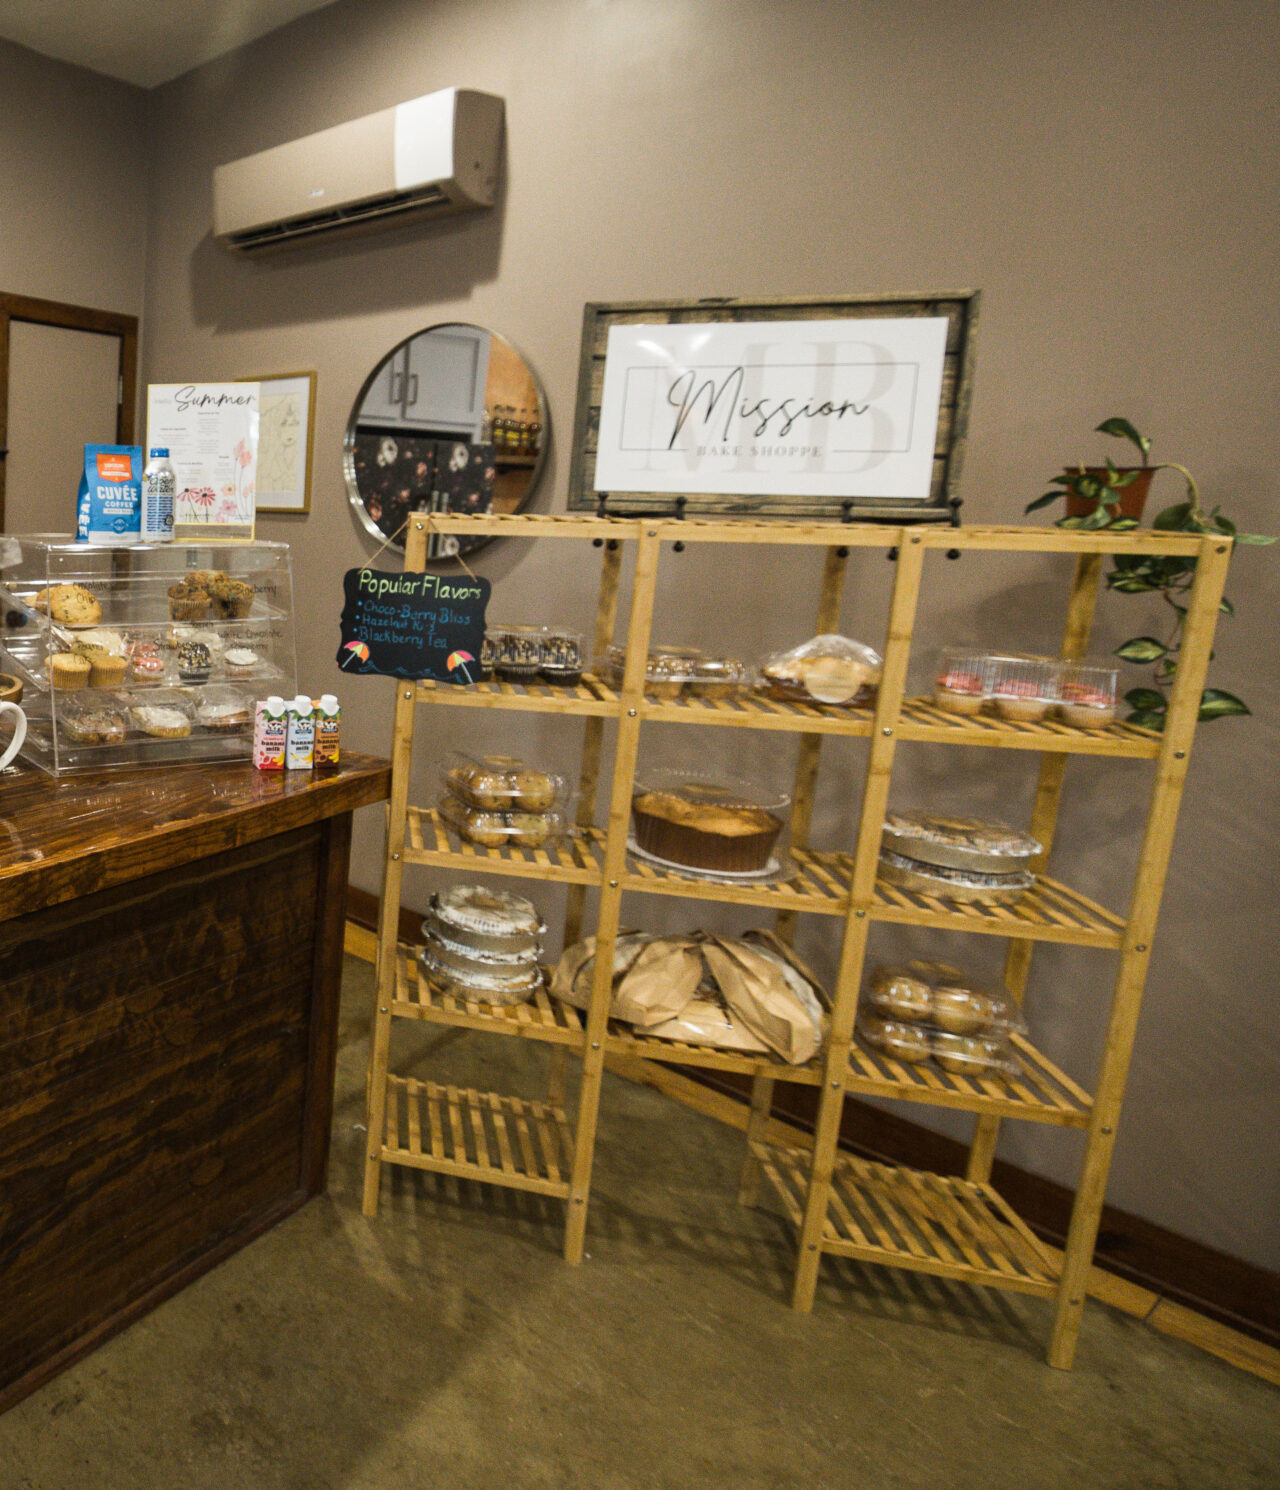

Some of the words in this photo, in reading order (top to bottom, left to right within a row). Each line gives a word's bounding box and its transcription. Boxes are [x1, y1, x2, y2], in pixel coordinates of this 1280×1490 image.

[175, 385, 255, 412] Summer
[668, 366, 869, 451] Mission
[696, 444, 742, 458] BAKE
[750, 444, 824, 459] SHOPPE
[97, 485, 138, 502] CUVÉE
[359, 570, 420, 599] Popular
[422, 576, 482, 600] Flavors
[439, 607, 472, 625] Bliss
[358, 625, 424, 650] Blackberry
[428, 631, 448, 649] Tea
